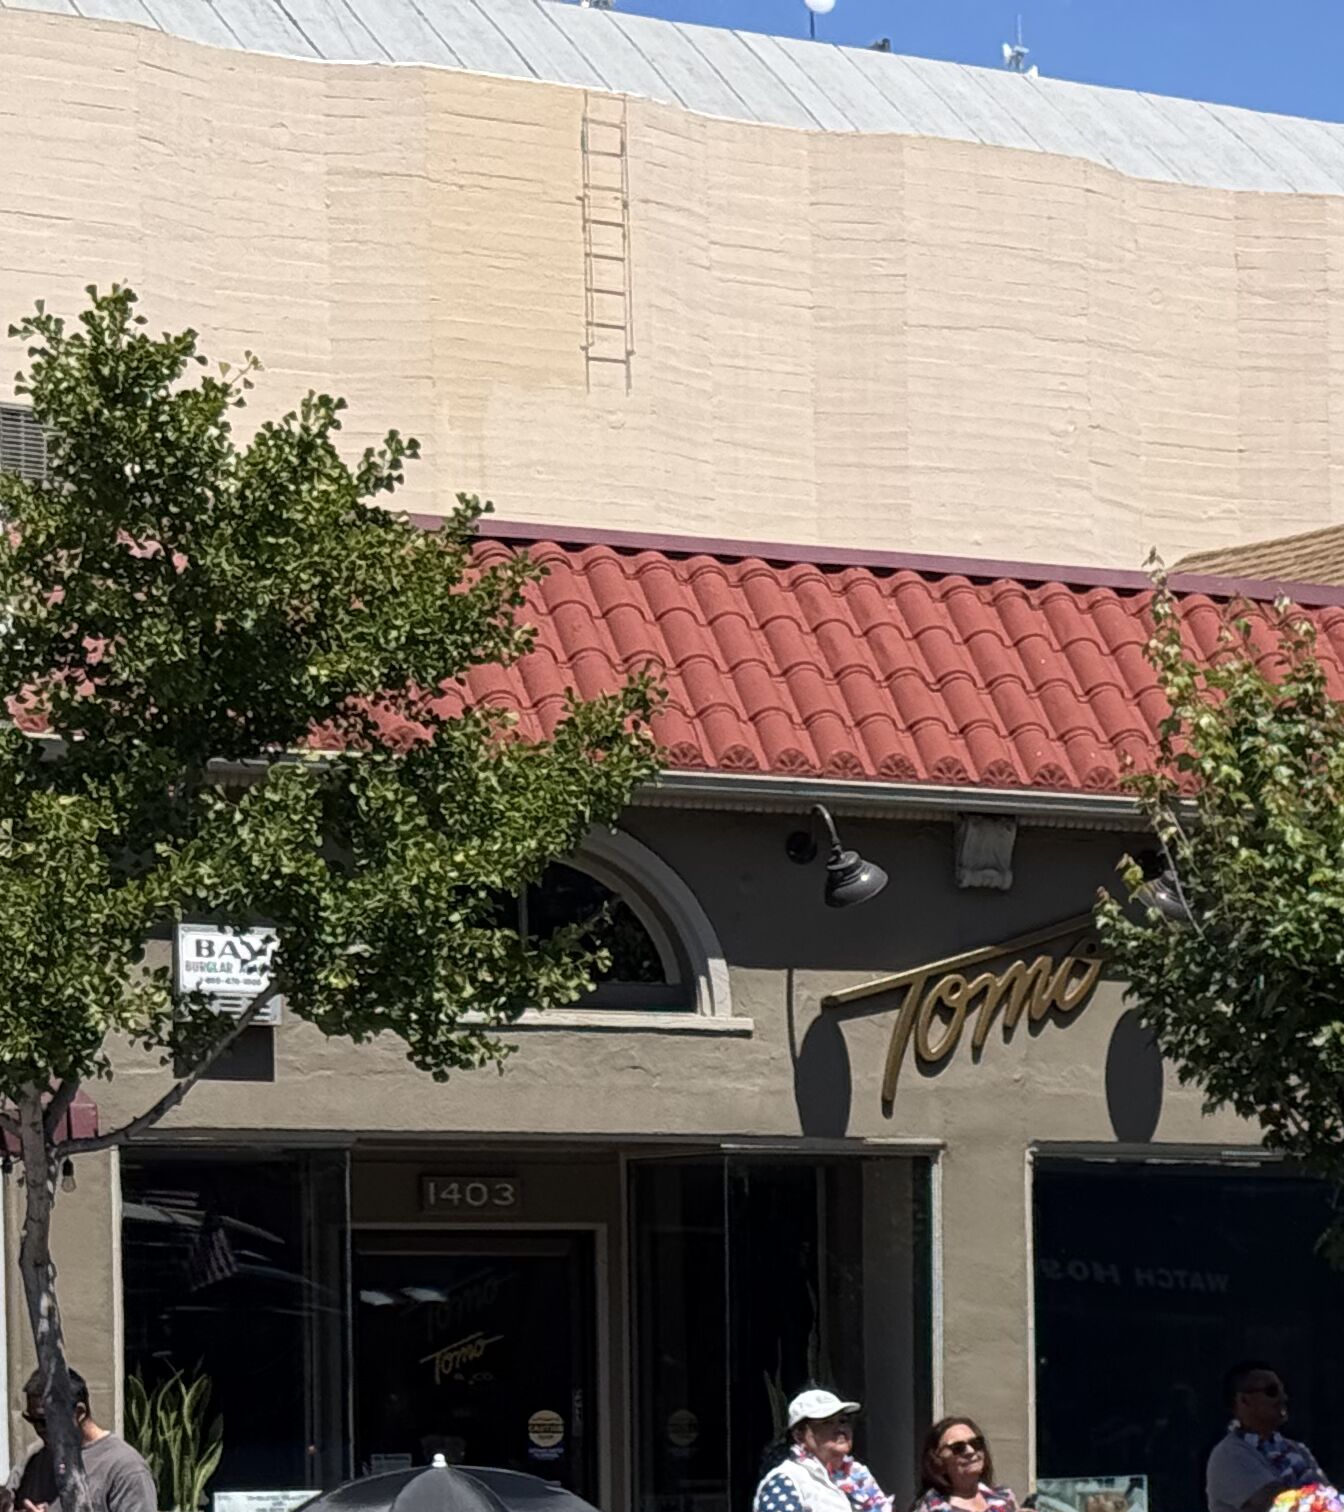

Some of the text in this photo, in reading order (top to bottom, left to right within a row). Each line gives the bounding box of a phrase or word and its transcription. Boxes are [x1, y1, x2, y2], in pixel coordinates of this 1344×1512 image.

[195, 938, 267, 961] BAY
[428, 1181, 516, 1206] 1403
[418, 1331, 505, 1385] Tomo
